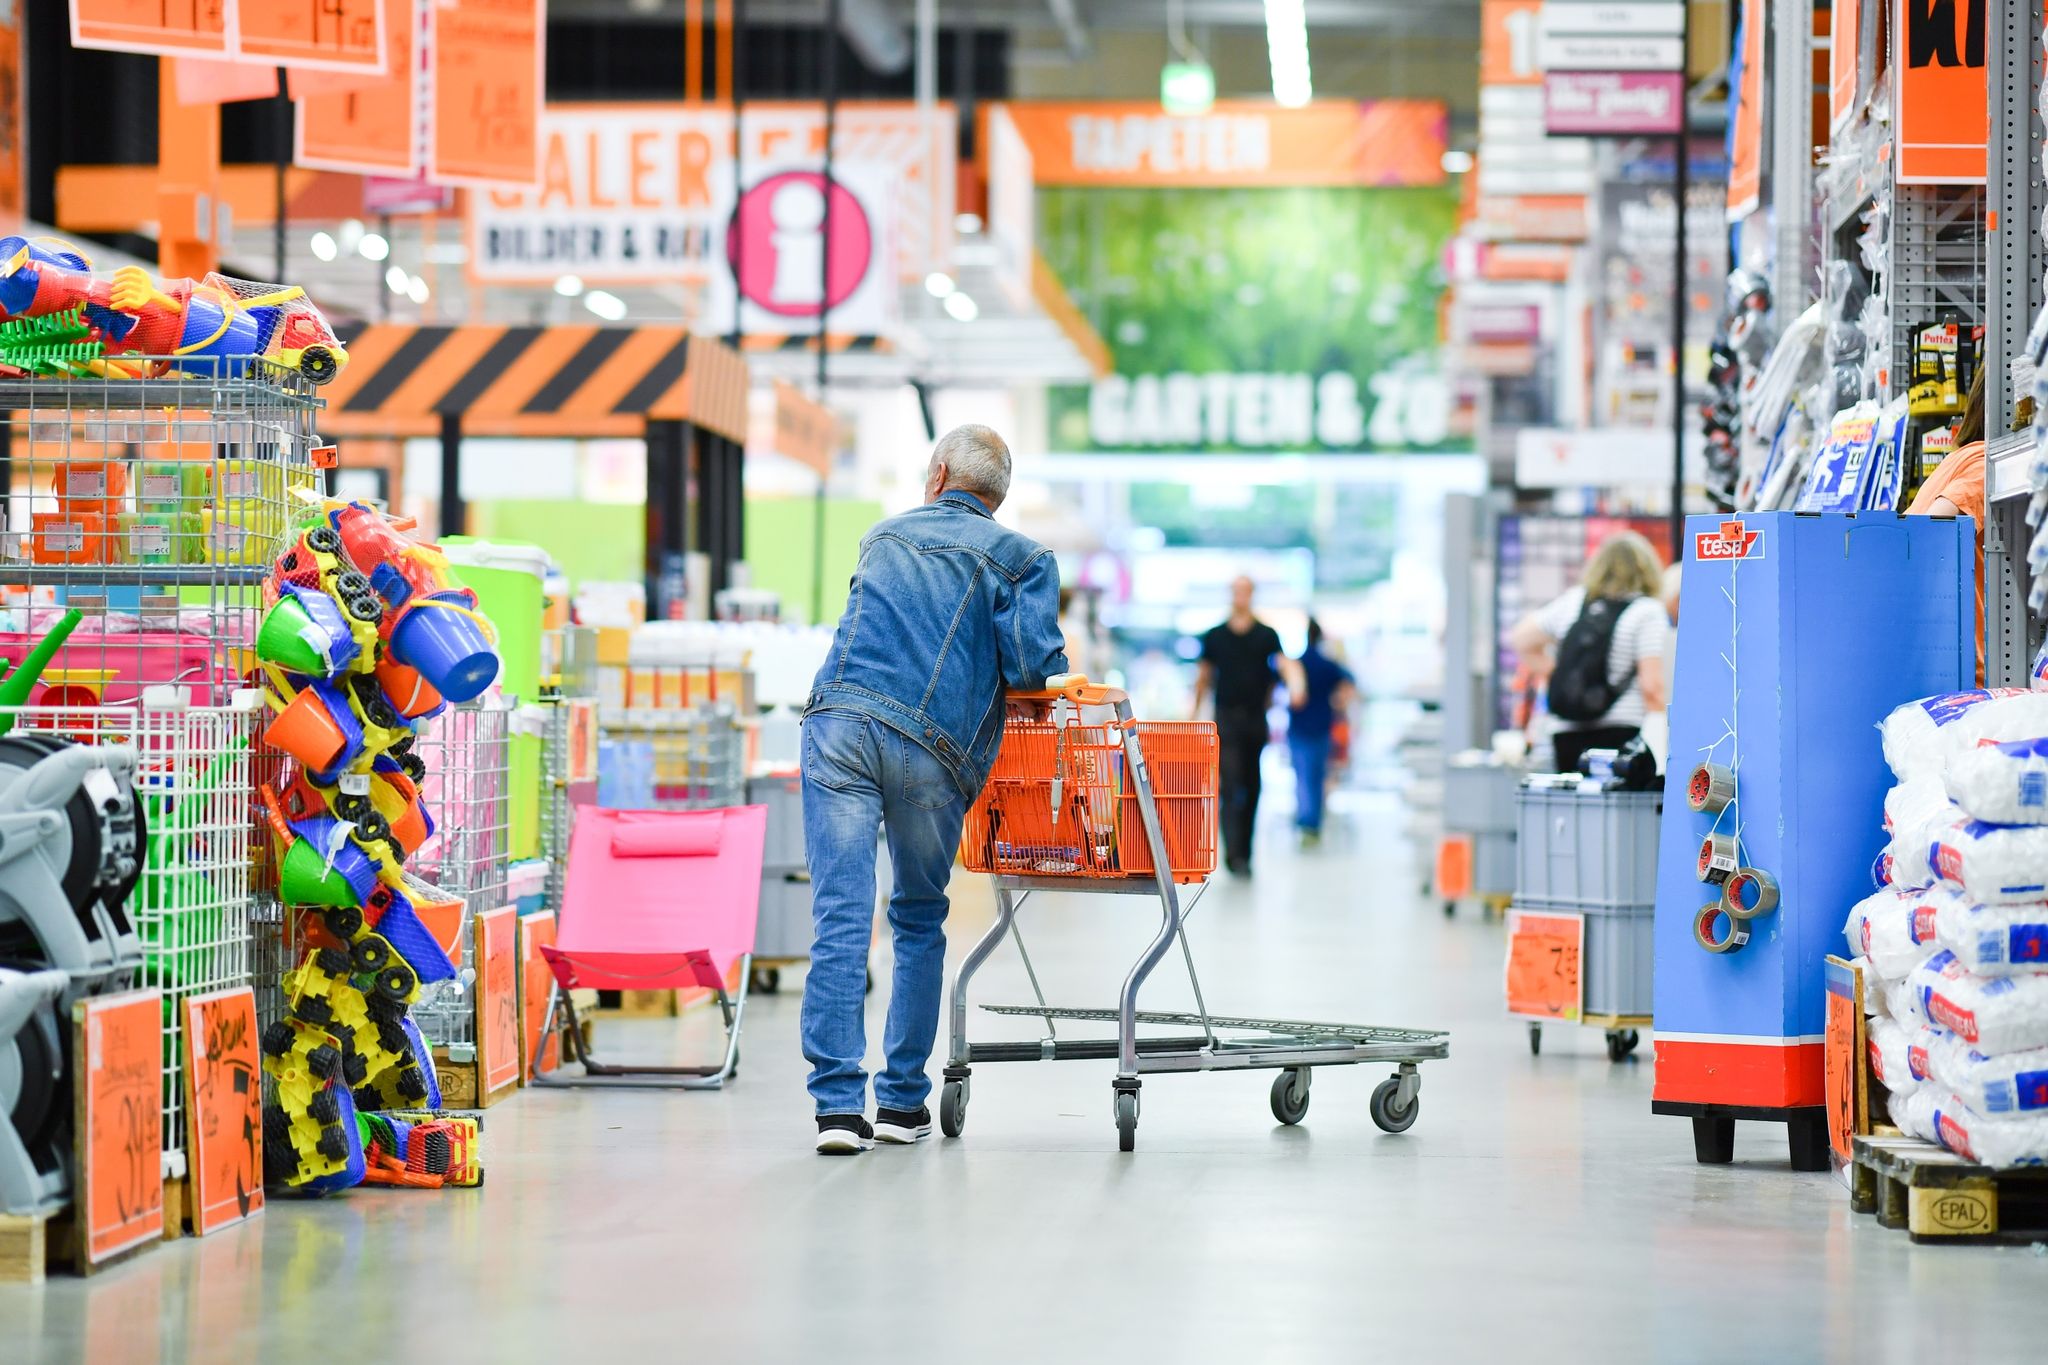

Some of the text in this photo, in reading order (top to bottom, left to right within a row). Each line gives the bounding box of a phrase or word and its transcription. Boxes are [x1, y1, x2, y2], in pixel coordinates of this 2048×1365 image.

[1069, 114, 1270, 173] TAPETEN
[1924, 333, 1953, 344] Pattex
[1090, 371, 1314, 447] GARTEN
[1701, 537, 1742, 556] tesa
[1940, 1202, 1979, 1221] EPAL
